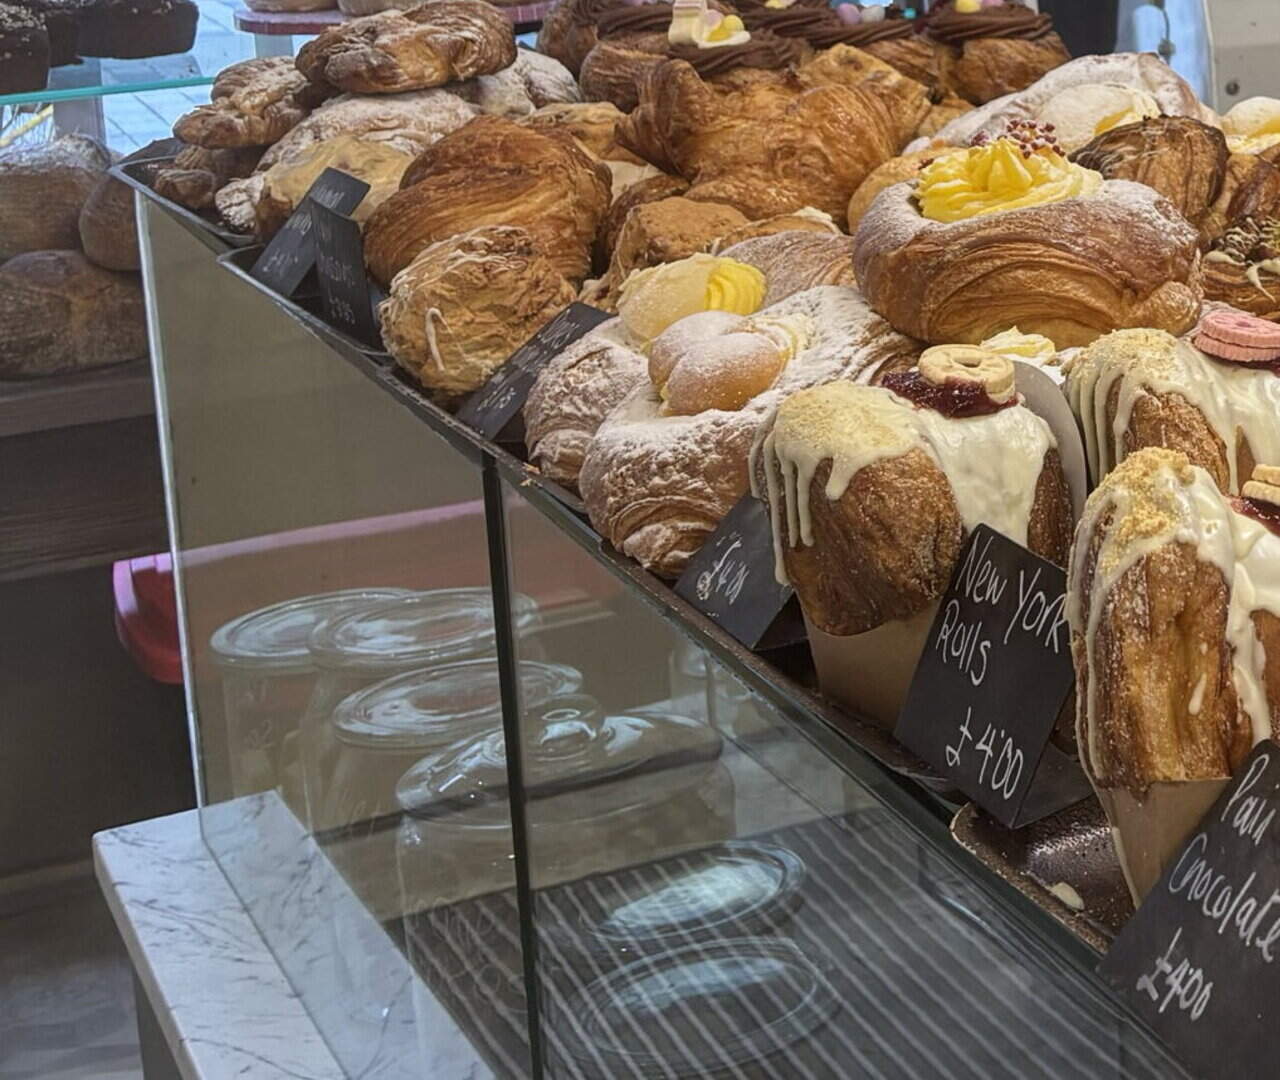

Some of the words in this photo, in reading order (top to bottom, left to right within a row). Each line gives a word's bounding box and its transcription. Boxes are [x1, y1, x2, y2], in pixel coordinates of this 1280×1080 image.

[955, 530, 1008, 606] New
[1003, 567, 1068, 655] York
[935, 598, 991, 686] Rolls
[1220, 753, 1280, 846] Pain
